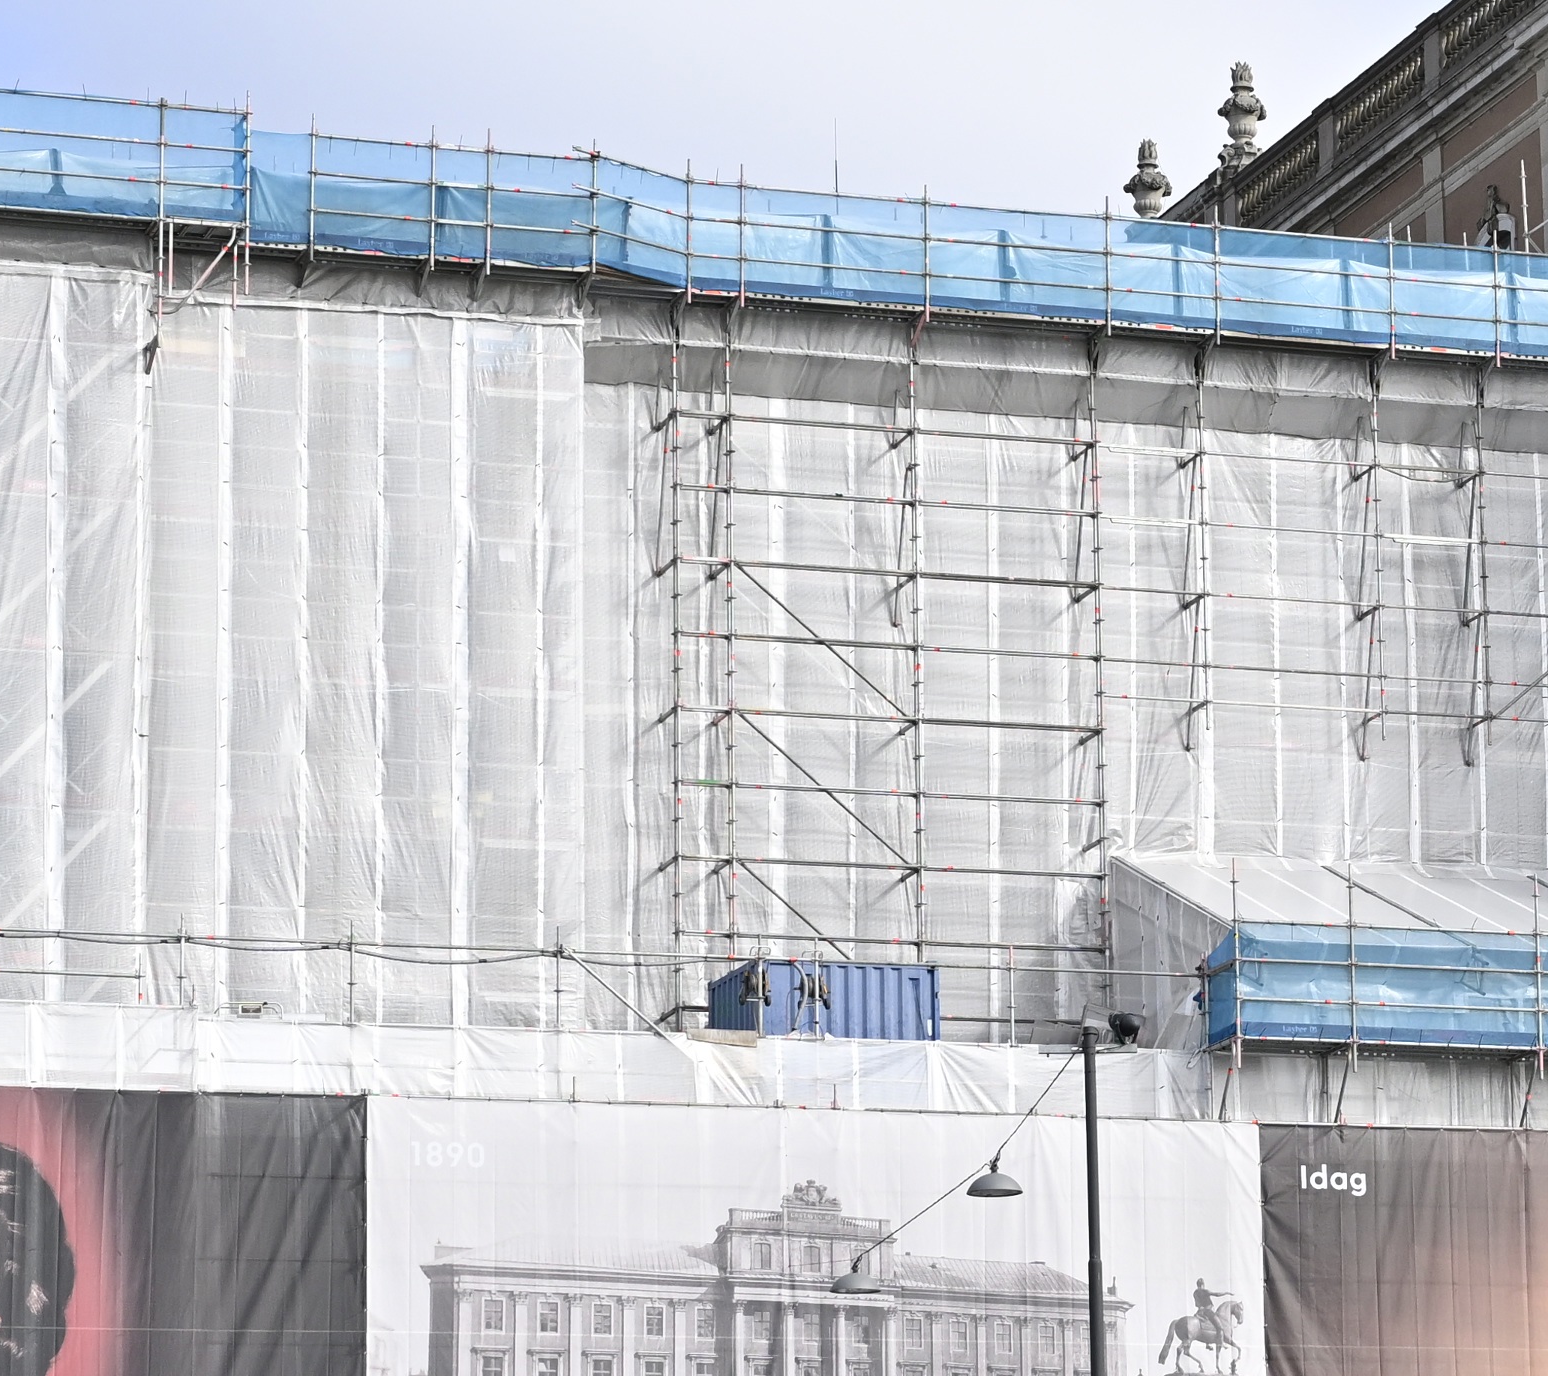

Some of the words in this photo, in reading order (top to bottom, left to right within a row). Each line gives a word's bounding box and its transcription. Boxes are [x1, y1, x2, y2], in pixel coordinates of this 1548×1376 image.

[1282, 1025, 1308, 1034] Layher
[411, 1140, 485, 1168] 1890
[1301, 1164, 1367, 1196] Idag
